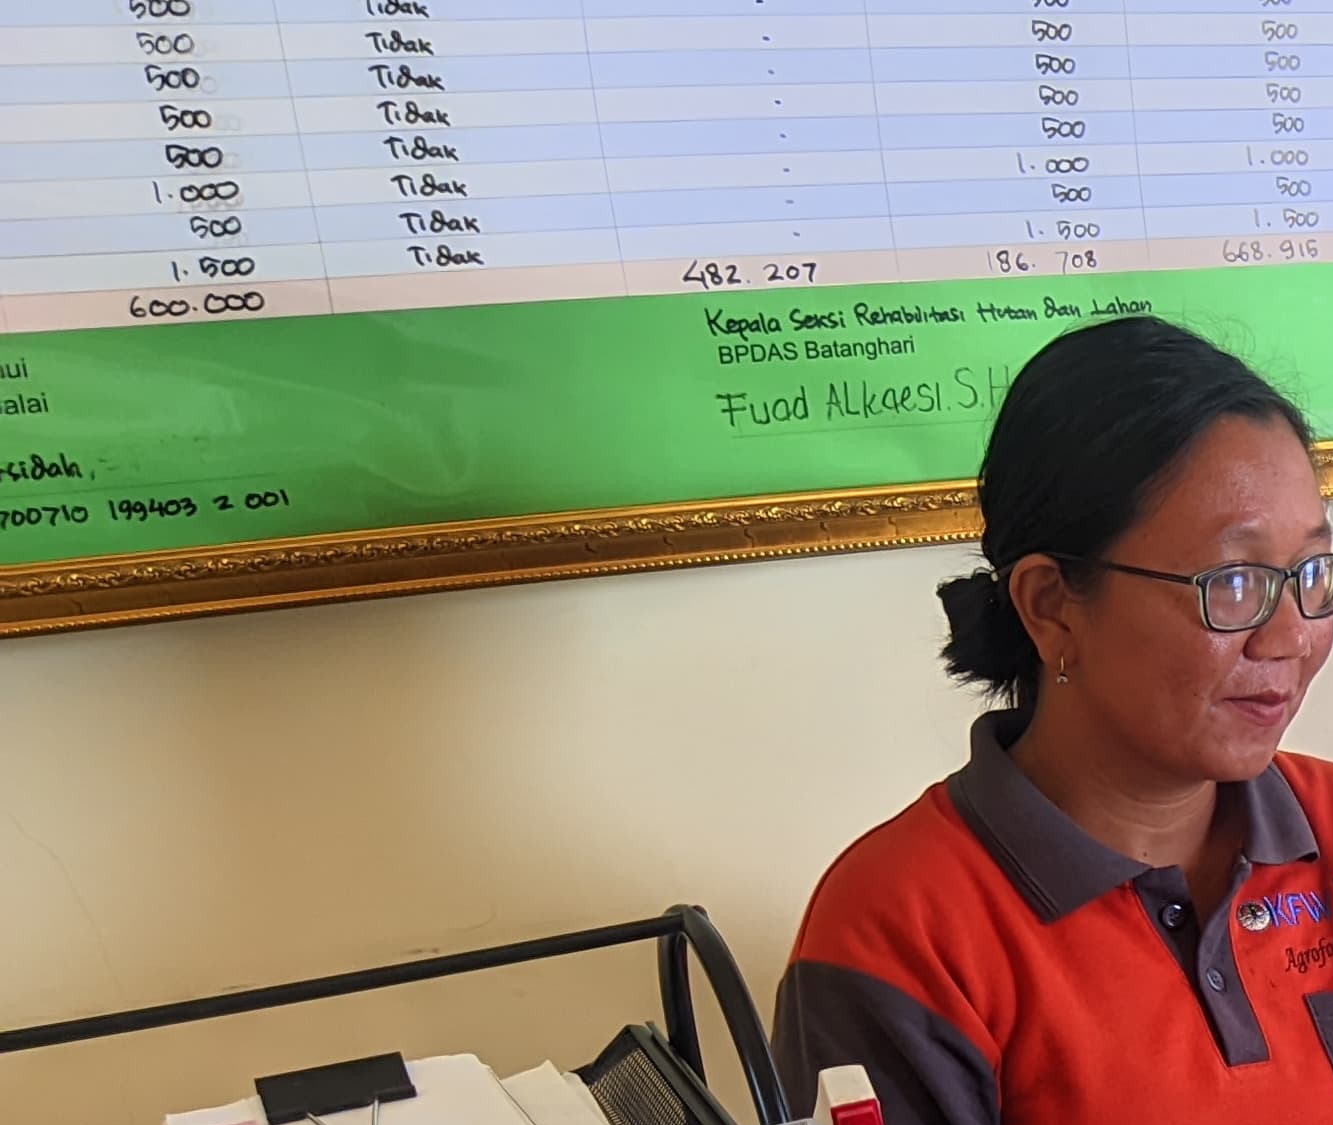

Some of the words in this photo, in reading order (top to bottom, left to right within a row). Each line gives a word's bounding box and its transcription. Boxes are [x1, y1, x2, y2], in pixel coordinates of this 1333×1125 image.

[128, 0, 191, 19] 500
[364, 29, 435, 56] Tidak
[1031, 19, 1073, 42] 500
[1261, 19, 1298, 43] 500
[135, 31, 195, 56] 500
[1034, 52, 1077, 75] 500
[1263, 50, 1301, 72] 500
[143, 64, 201, 92] 500
[367, 64, 446, 91] Tidak
[1038, 84, 1080, 107] 500
[1265, 82, 1302, 103] 500
[159, 103, 212, 131] 500
[376, 100, 452, 127] Tidak
[1271, 112, 1305, 135] 500
[1041, 116, 1086, 139] 500
[164, 143, 224, 170] 500
[382, 135, 460, 162] Tidak
[151, 180, 240, 205] 1.000
[390, 173, 468, 198] Tidak
[1050, 182, 1093, 203] 500
[1275, 175, 1312, 198] 500
[189, 214, 242, 239] 500
[398, 209, 481, 234] Tidak
[406, 244, 485, 267] Tidak
[128, 290, 266, 318] 600.000
[703, 306, 783, 342] Kepala
[1089, 295, 1153, 317] Lahan
[717, 341, 798, 366] BPDAS
[803, 335, 916, 361] Batanghari
[0, 391, 50, 416] alai
[714, 384, 810, 428] Fuad
[107, 496, 199, 522] 199403
[212, 494, 236, 512] 2
[244, 488, 291, 510] 001
